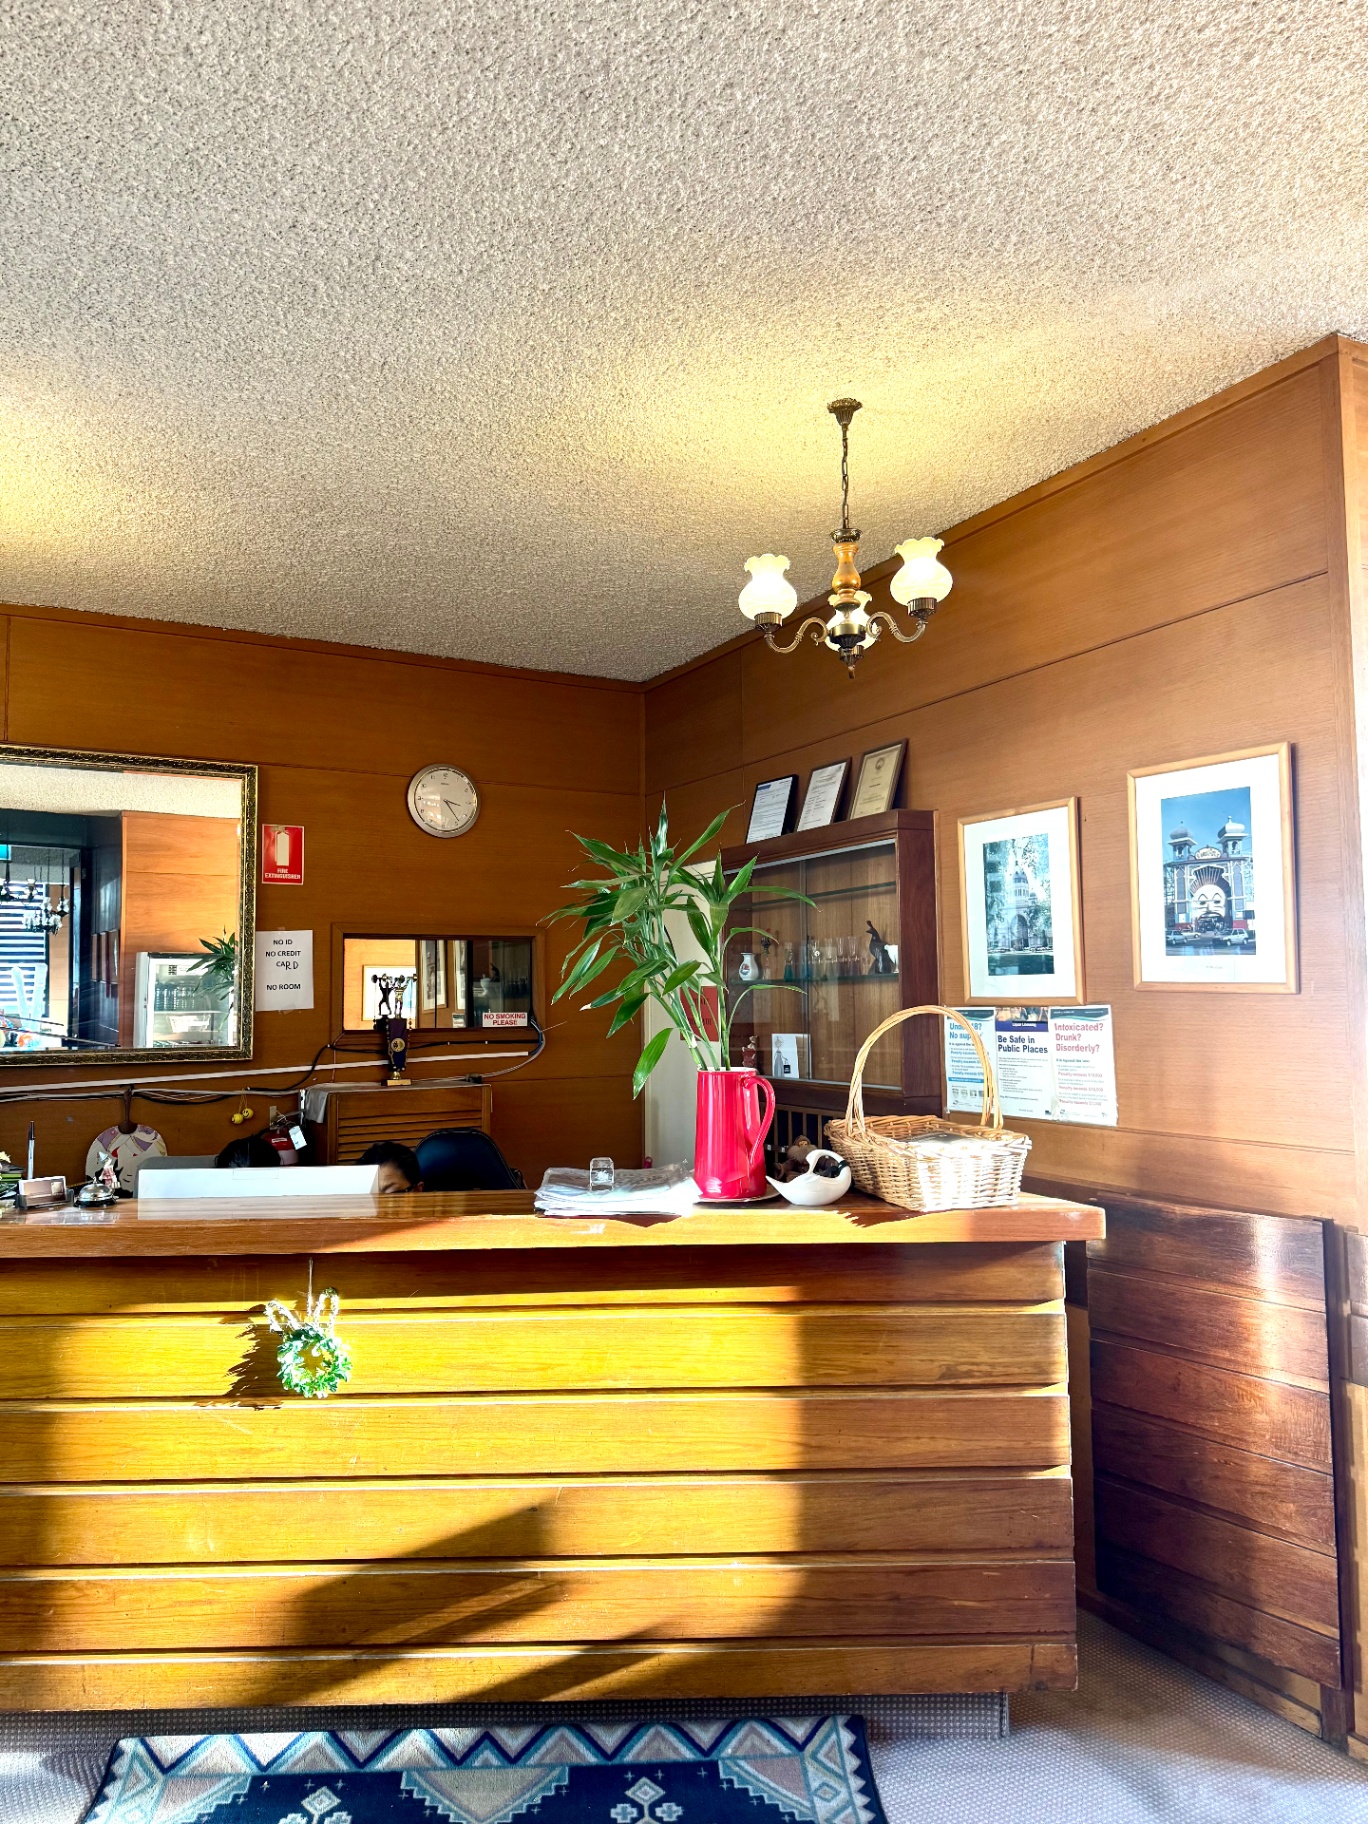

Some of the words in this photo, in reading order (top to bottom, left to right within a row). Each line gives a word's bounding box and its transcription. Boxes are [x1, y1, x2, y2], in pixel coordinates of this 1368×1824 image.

[1054, 1022, 1104, 1031] Intoxicated?
[1010, 1035, 1026, 1044] Safe
[1028, 1036, 1036, 1044] in
[1056, 1033, 1082, 1041] Drunk?
[998, 1044, 1020, 1052] Public
[1022, 1045, 1048, 1054] Places
[1056, 1044, 1100, 1054] Disorderly?
